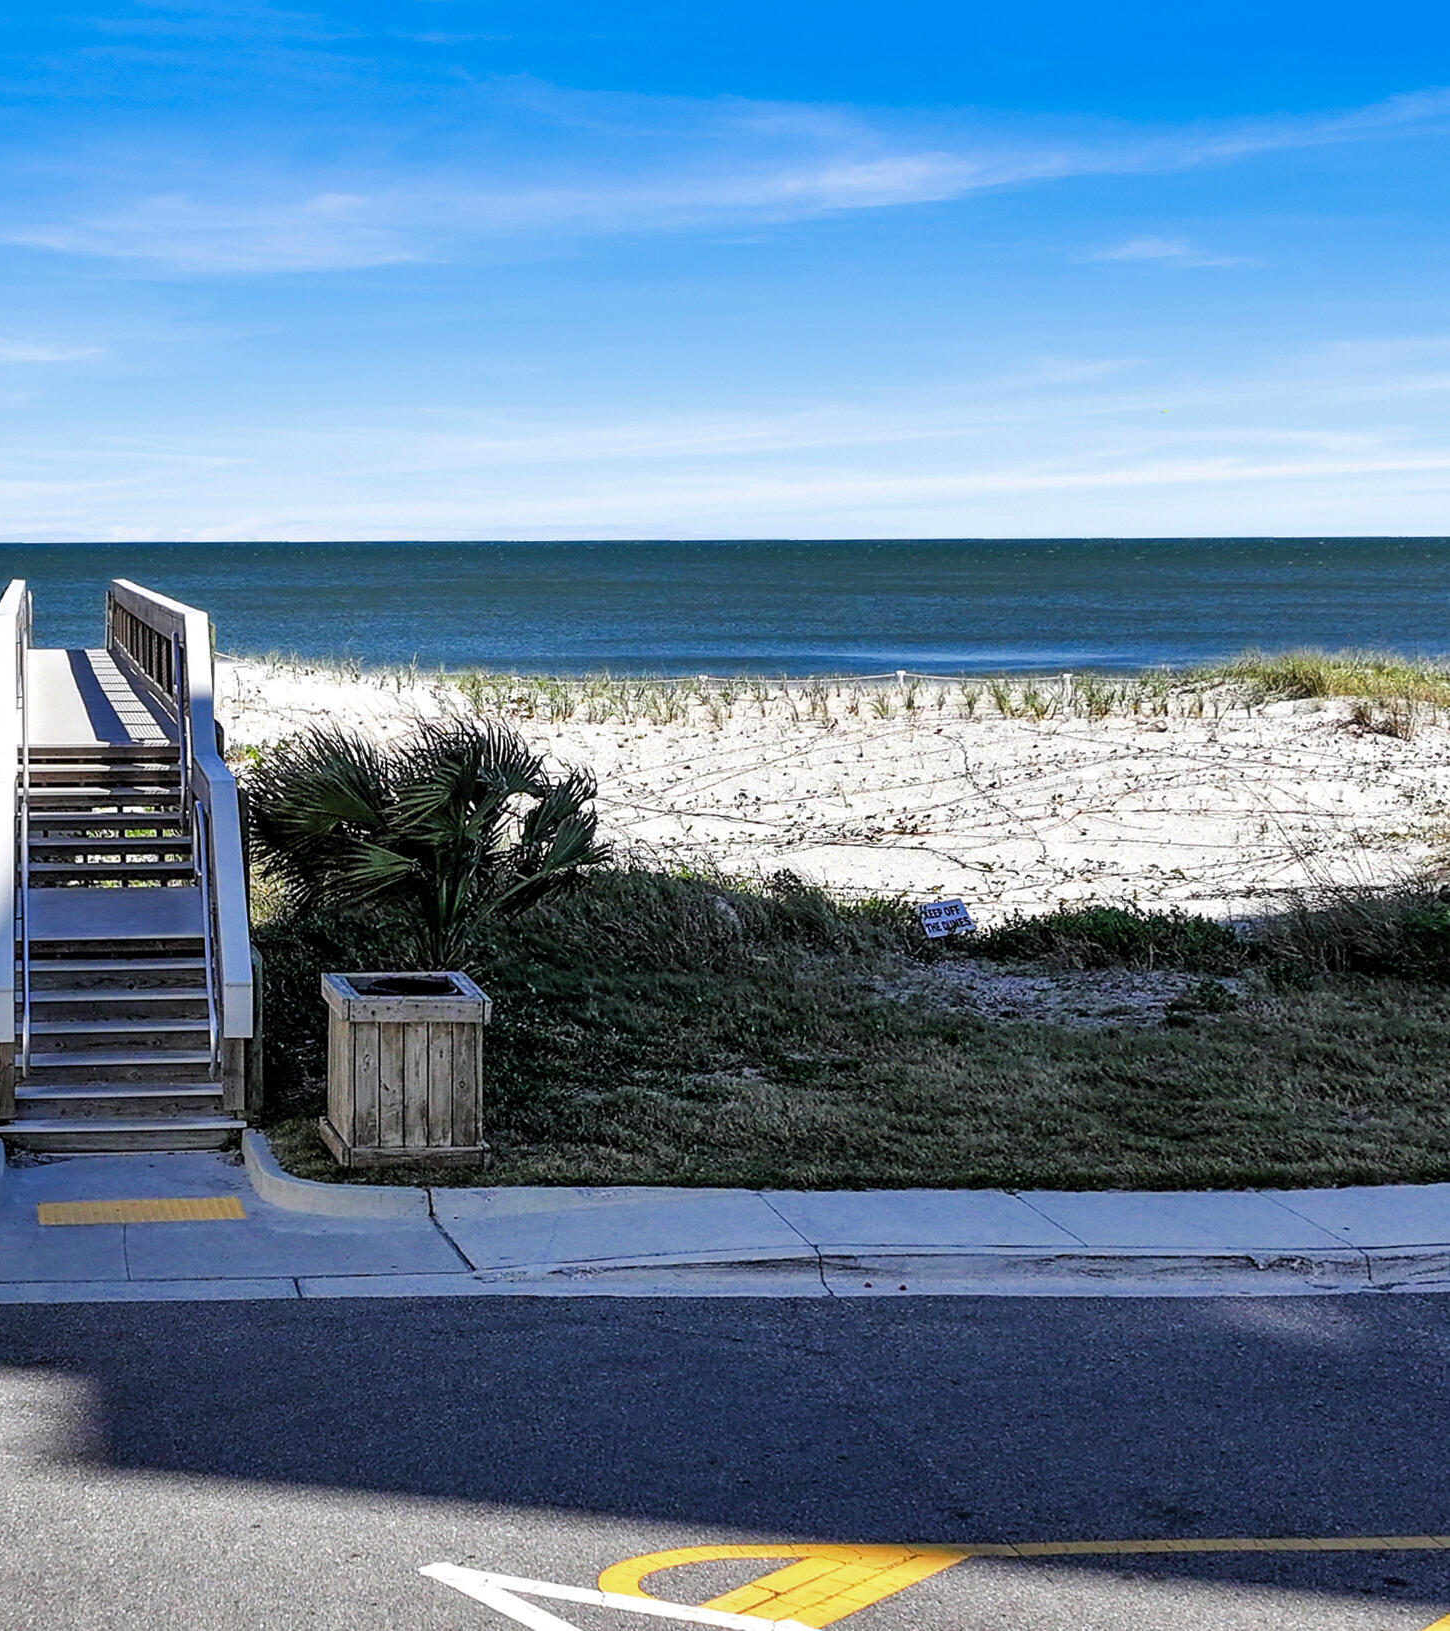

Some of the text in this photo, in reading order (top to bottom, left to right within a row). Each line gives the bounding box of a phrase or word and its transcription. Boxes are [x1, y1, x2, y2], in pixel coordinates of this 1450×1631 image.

[920, 905, 960, 920] KEEP OFF
[925, 916, 972, 933] THE DUNES
